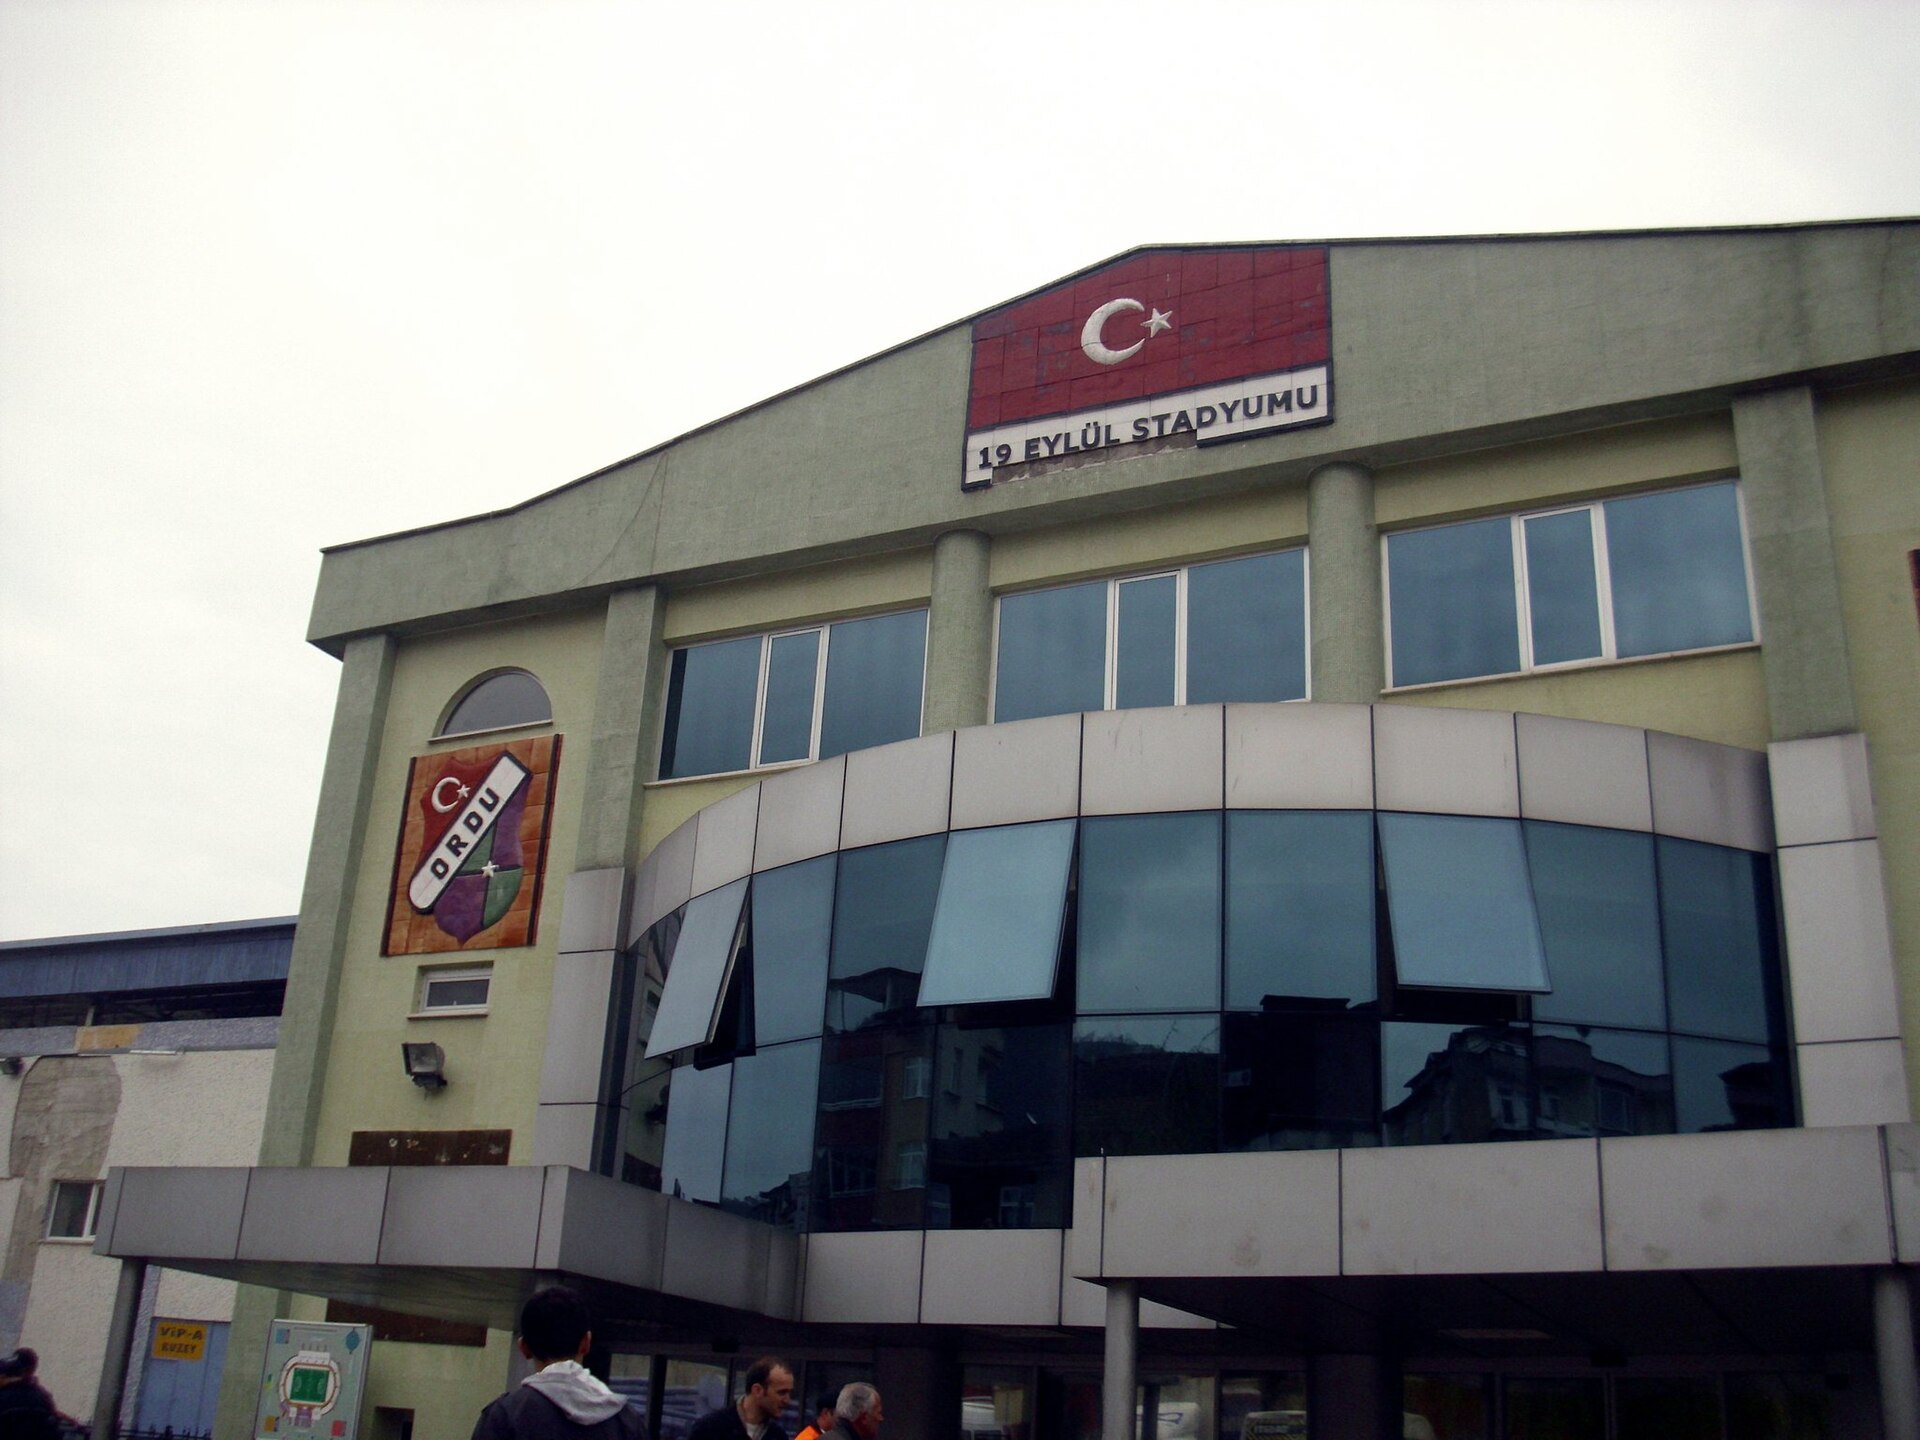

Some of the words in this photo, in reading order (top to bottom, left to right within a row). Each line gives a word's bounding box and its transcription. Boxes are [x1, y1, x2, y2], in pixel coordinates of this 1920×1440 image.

[979, 444, 1012, 469] 19
[1024, 421, 1120, 461] EYLÜL
[1131, 385, 1317, 441] STADYUMU
[431, 787, 500, 880] ORDU
